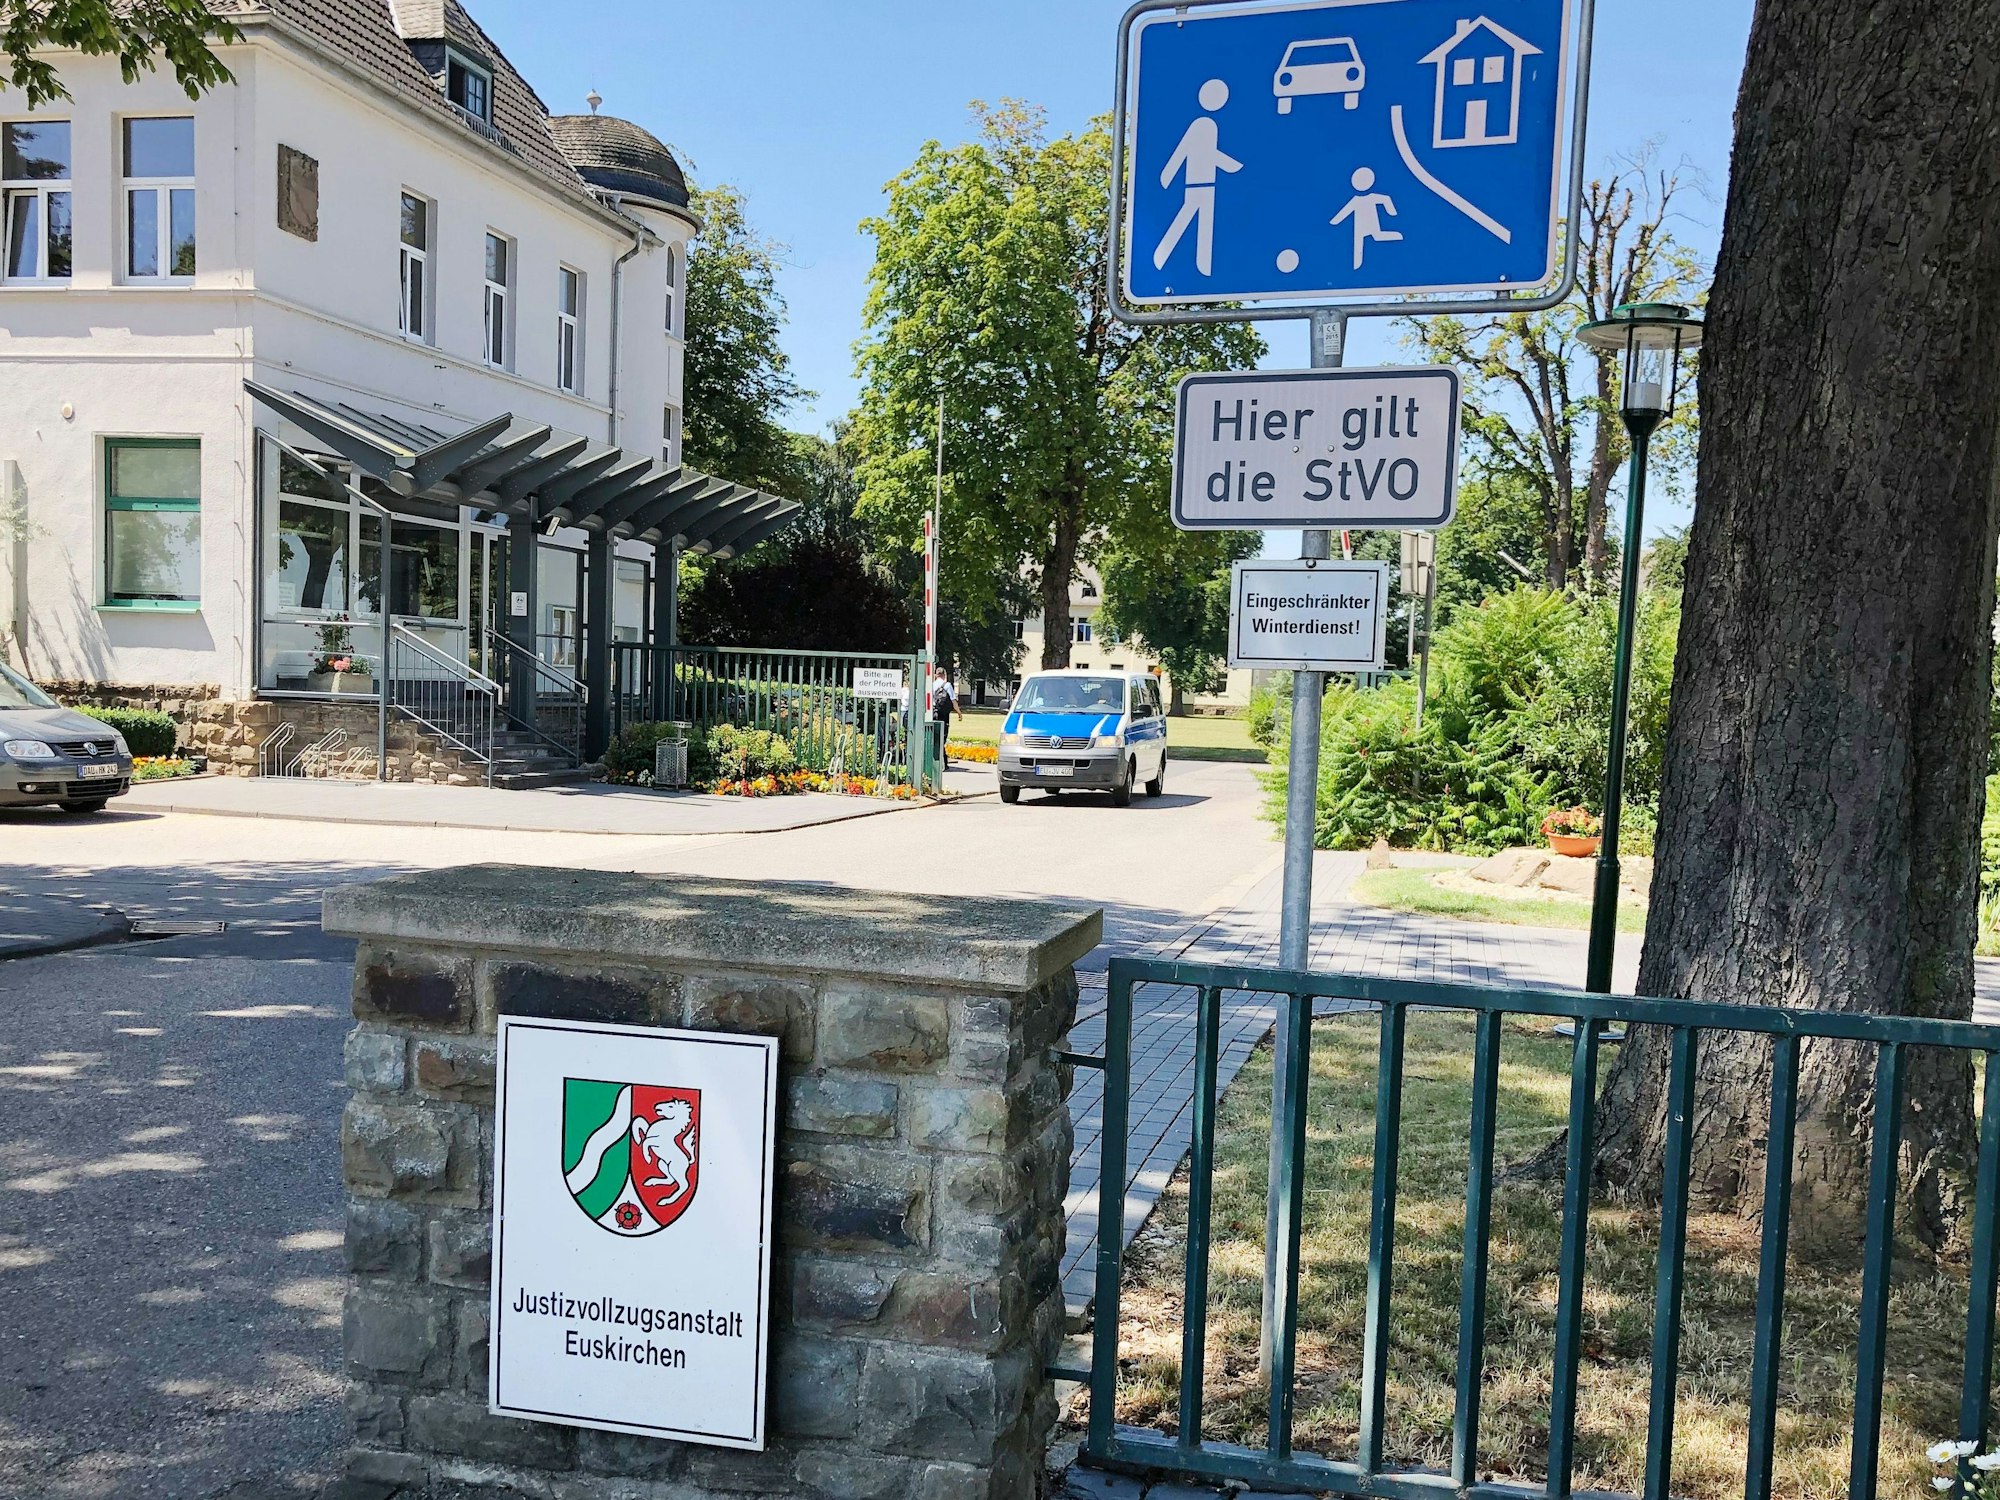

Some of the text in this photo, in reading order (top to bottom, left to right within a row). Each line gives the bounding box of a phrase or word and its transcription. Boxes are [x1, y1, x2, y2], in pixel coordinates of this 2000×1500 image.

[1212, 395, 1419, 451] Hier gilt
[1207, 457, 1419, 502] die StVO
[1246, 593, 1370, 612] Eingeschränkter
[1252, 618, 1360, 635] Winterdienst!
[863, 670, 881, 678] Bitte
[873, 680, 896, 688] Pforte
[513, 1287, 743, 1337] Justizvollzugsanstalt
[565, 1330, 686, 1369] Euskirchen
